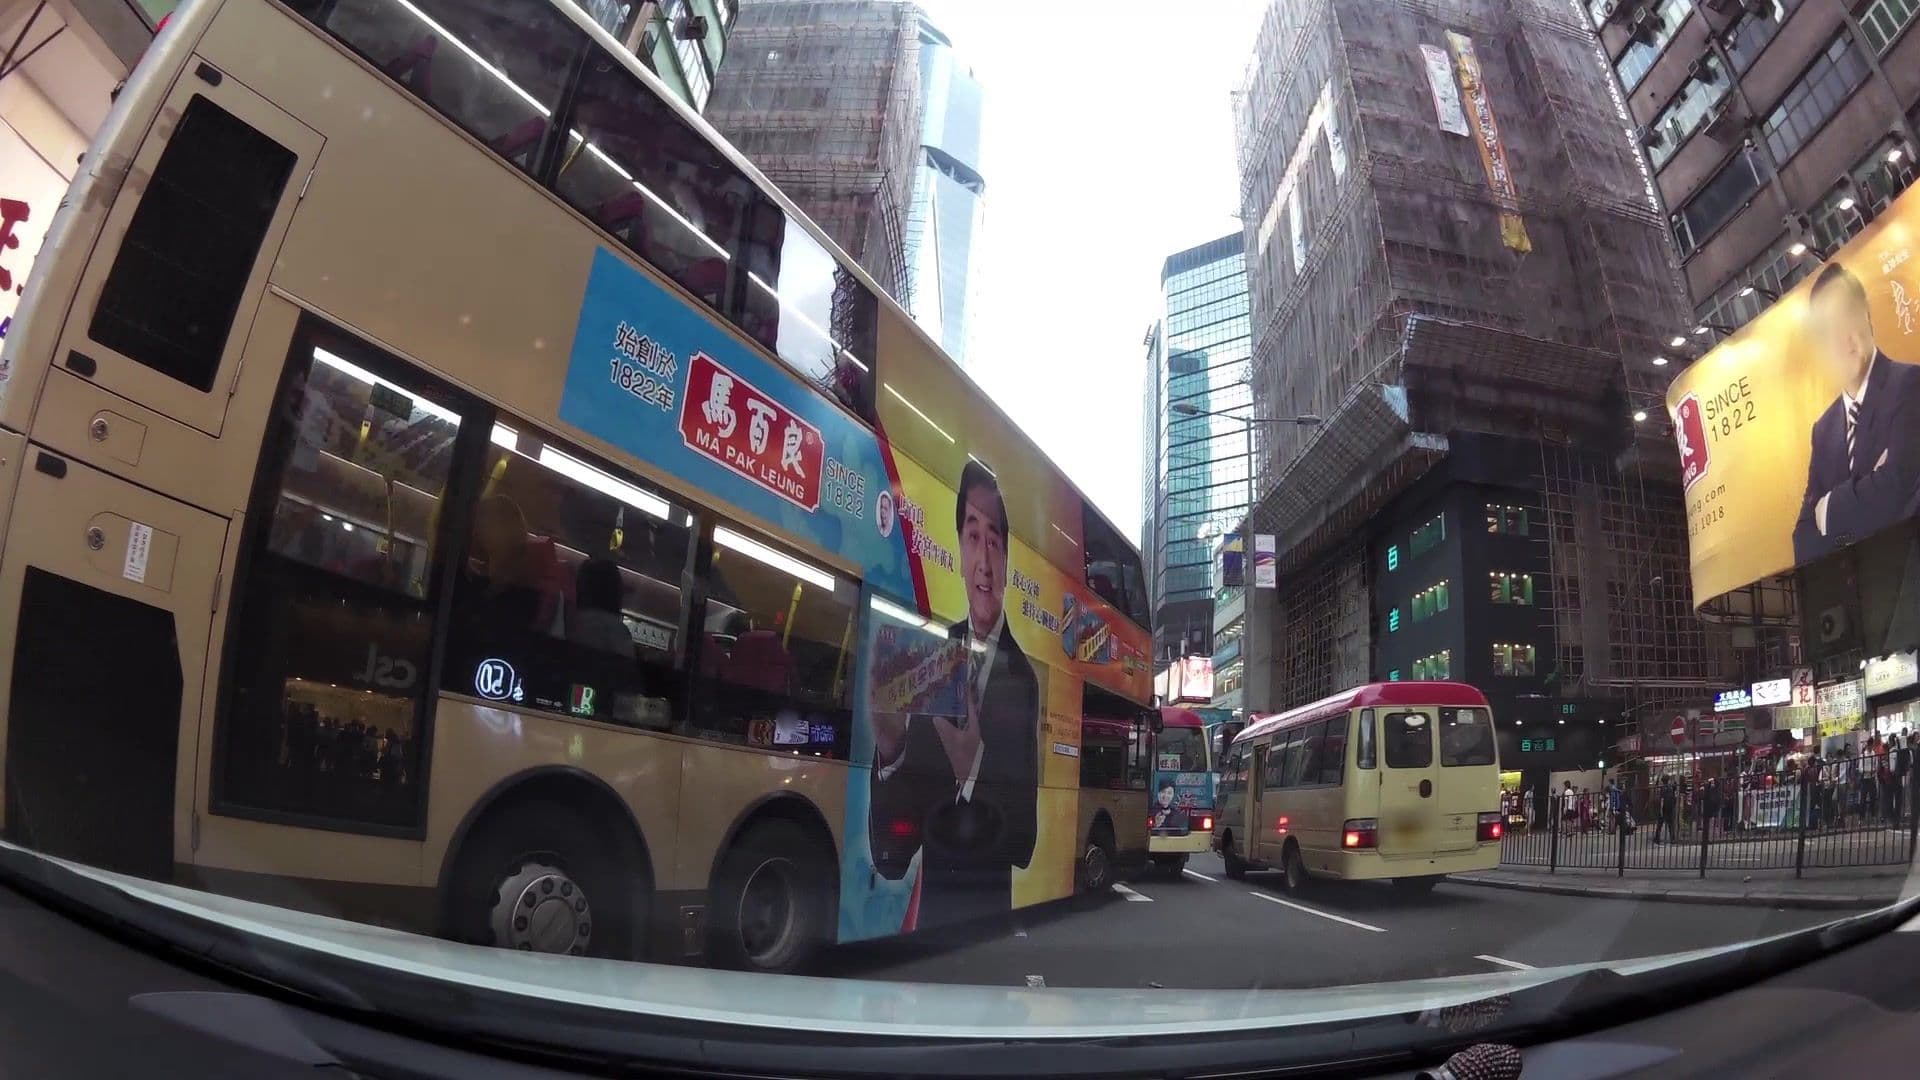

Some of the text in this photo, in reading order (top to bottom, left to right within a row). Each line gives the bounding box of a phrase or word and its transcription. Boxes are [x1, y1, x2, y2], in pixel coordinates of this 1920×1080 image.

[614, 320, 679, 383] 始創於
[609, 358, 675, 412] 1822年
[1705, 376, 1752, 421] SINCE
[702, 370, 806, 480] 馬百良
[1711, 400, 1757, 442] 1822
[696, 428, 805, 500] MA PAK LEUNG
[825, 456, 865, 496] SINCE
[826, 481, 864, 519] 1822
[1701, 505, 1725, 530] 1018
